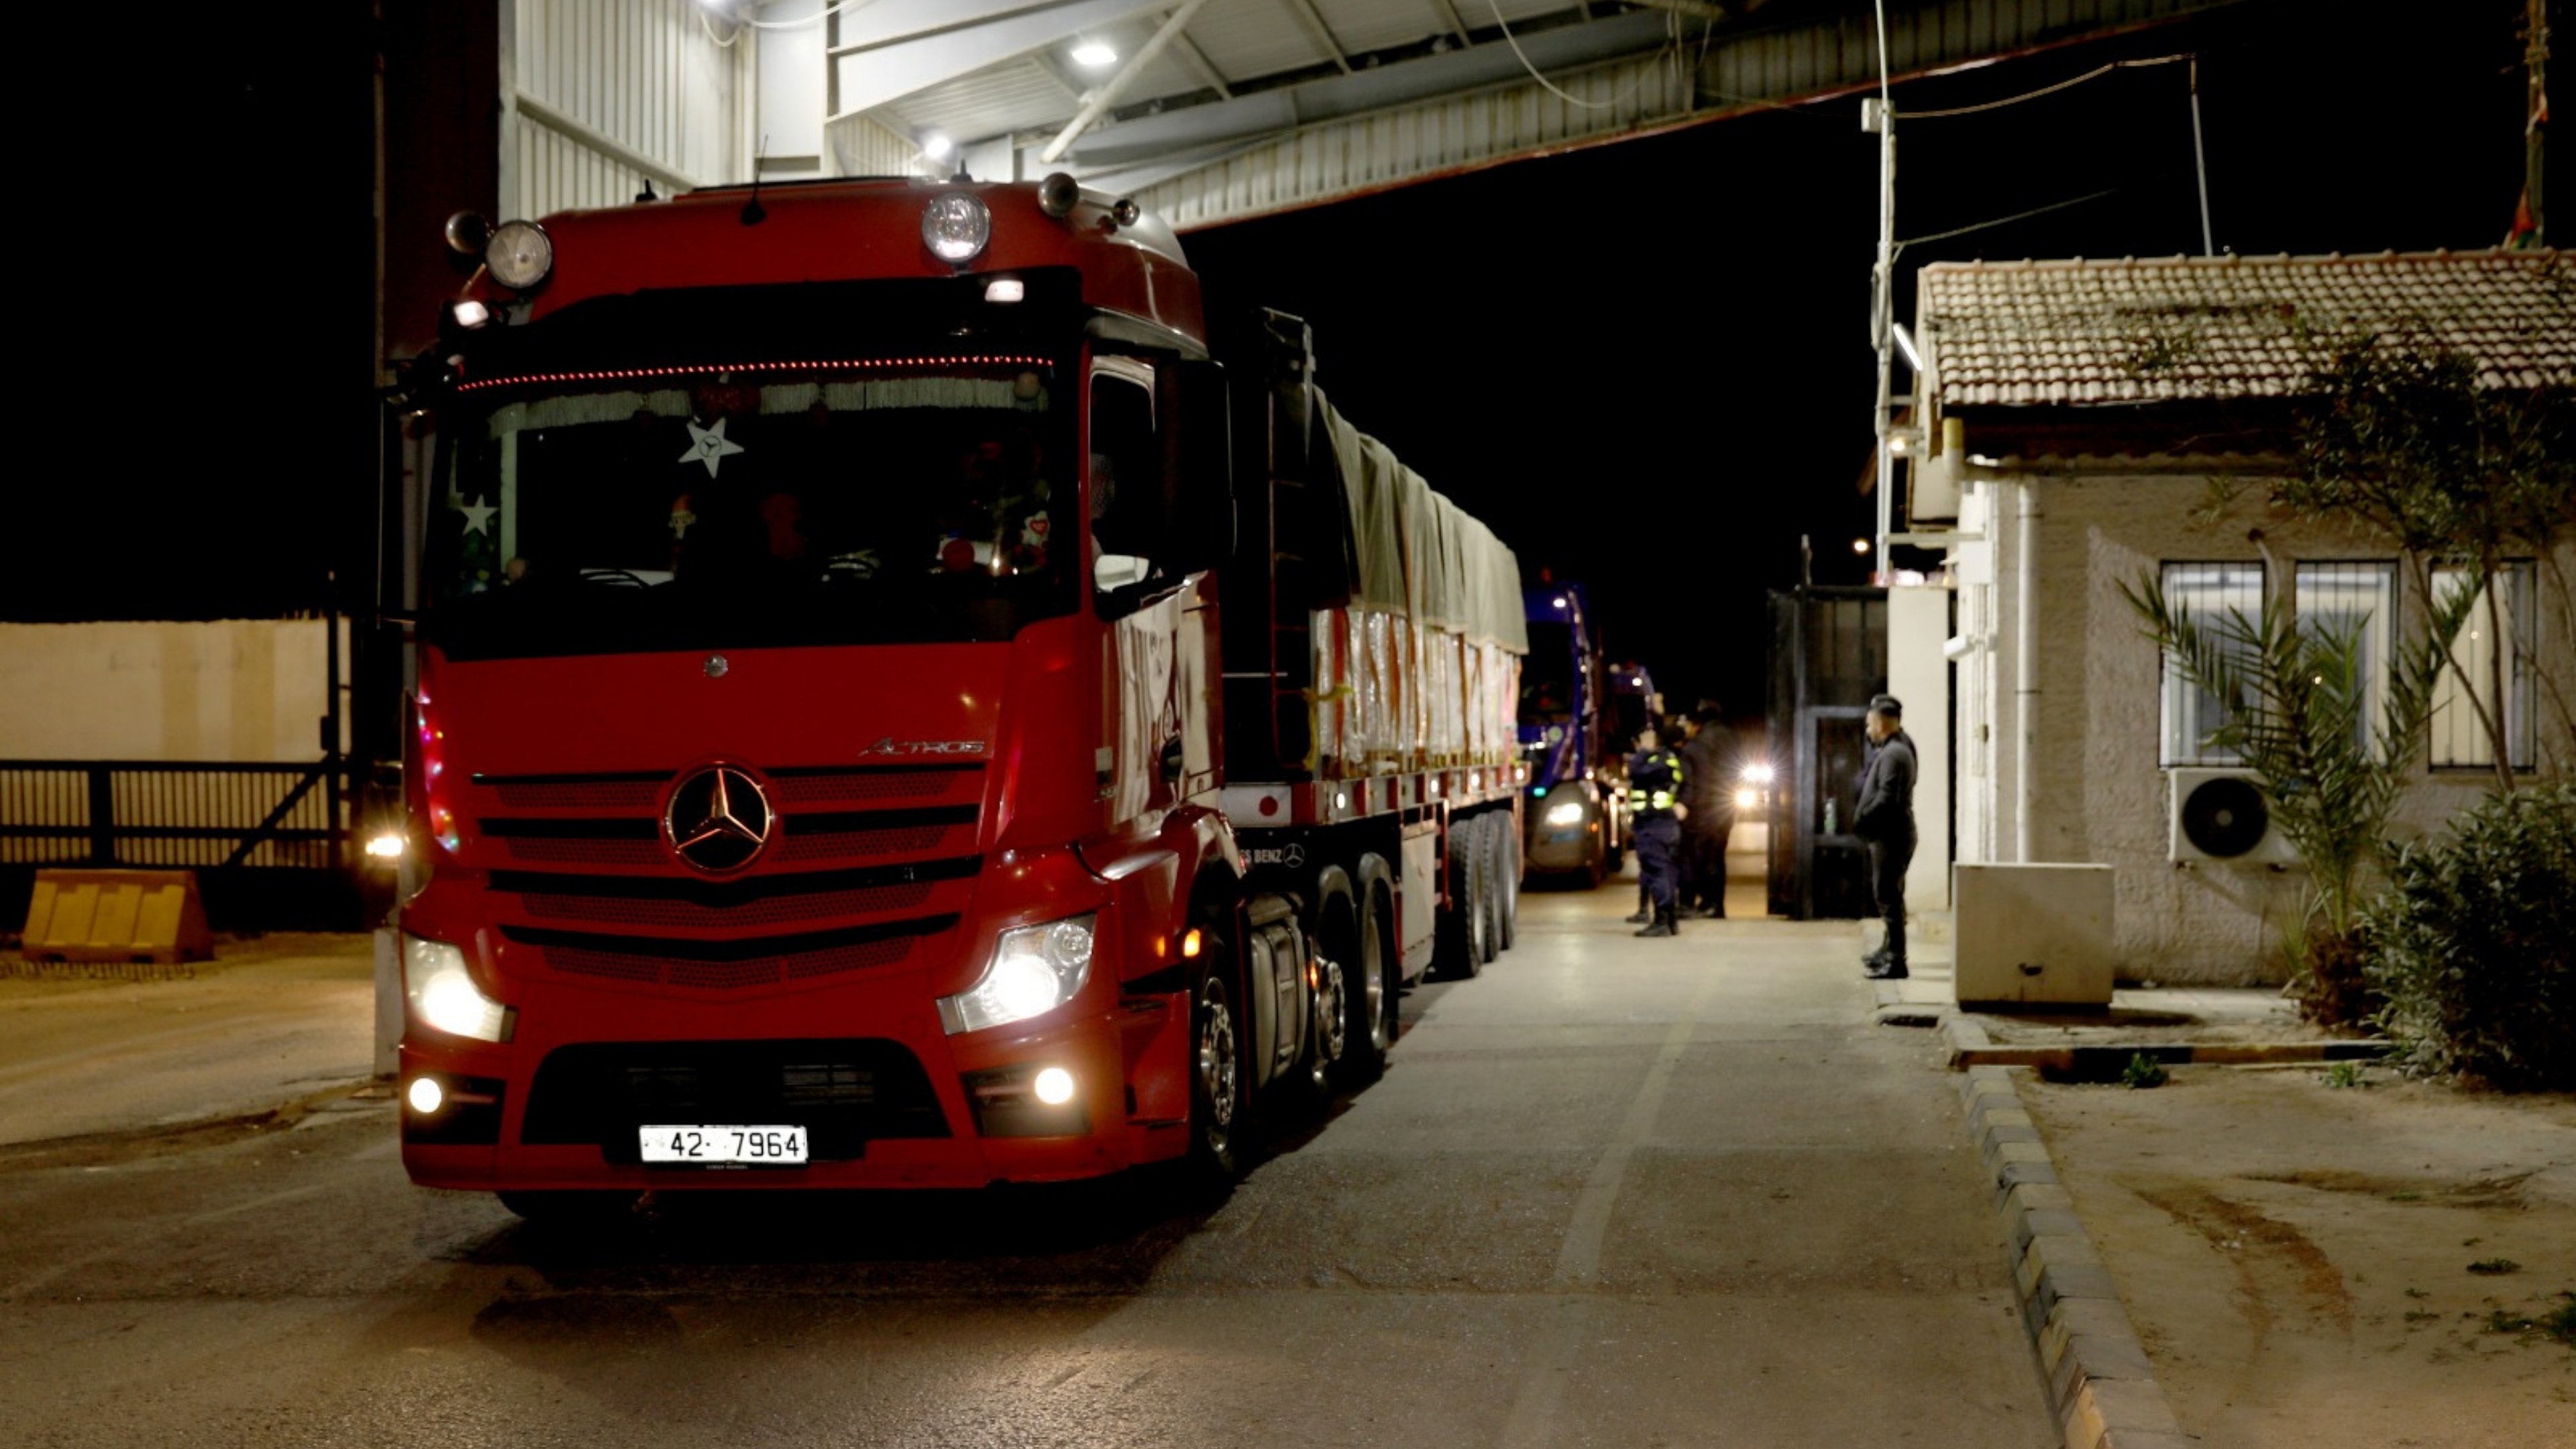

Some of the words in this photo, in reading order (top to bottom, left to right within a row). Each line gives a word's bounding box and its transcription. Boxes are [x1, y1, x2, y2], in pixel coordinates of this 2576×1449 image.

[857, 737, 985, 757] ACTROS
[1254, 849, 1283, 863] BENZ
[731, 1132, 800, 1157] 7964
